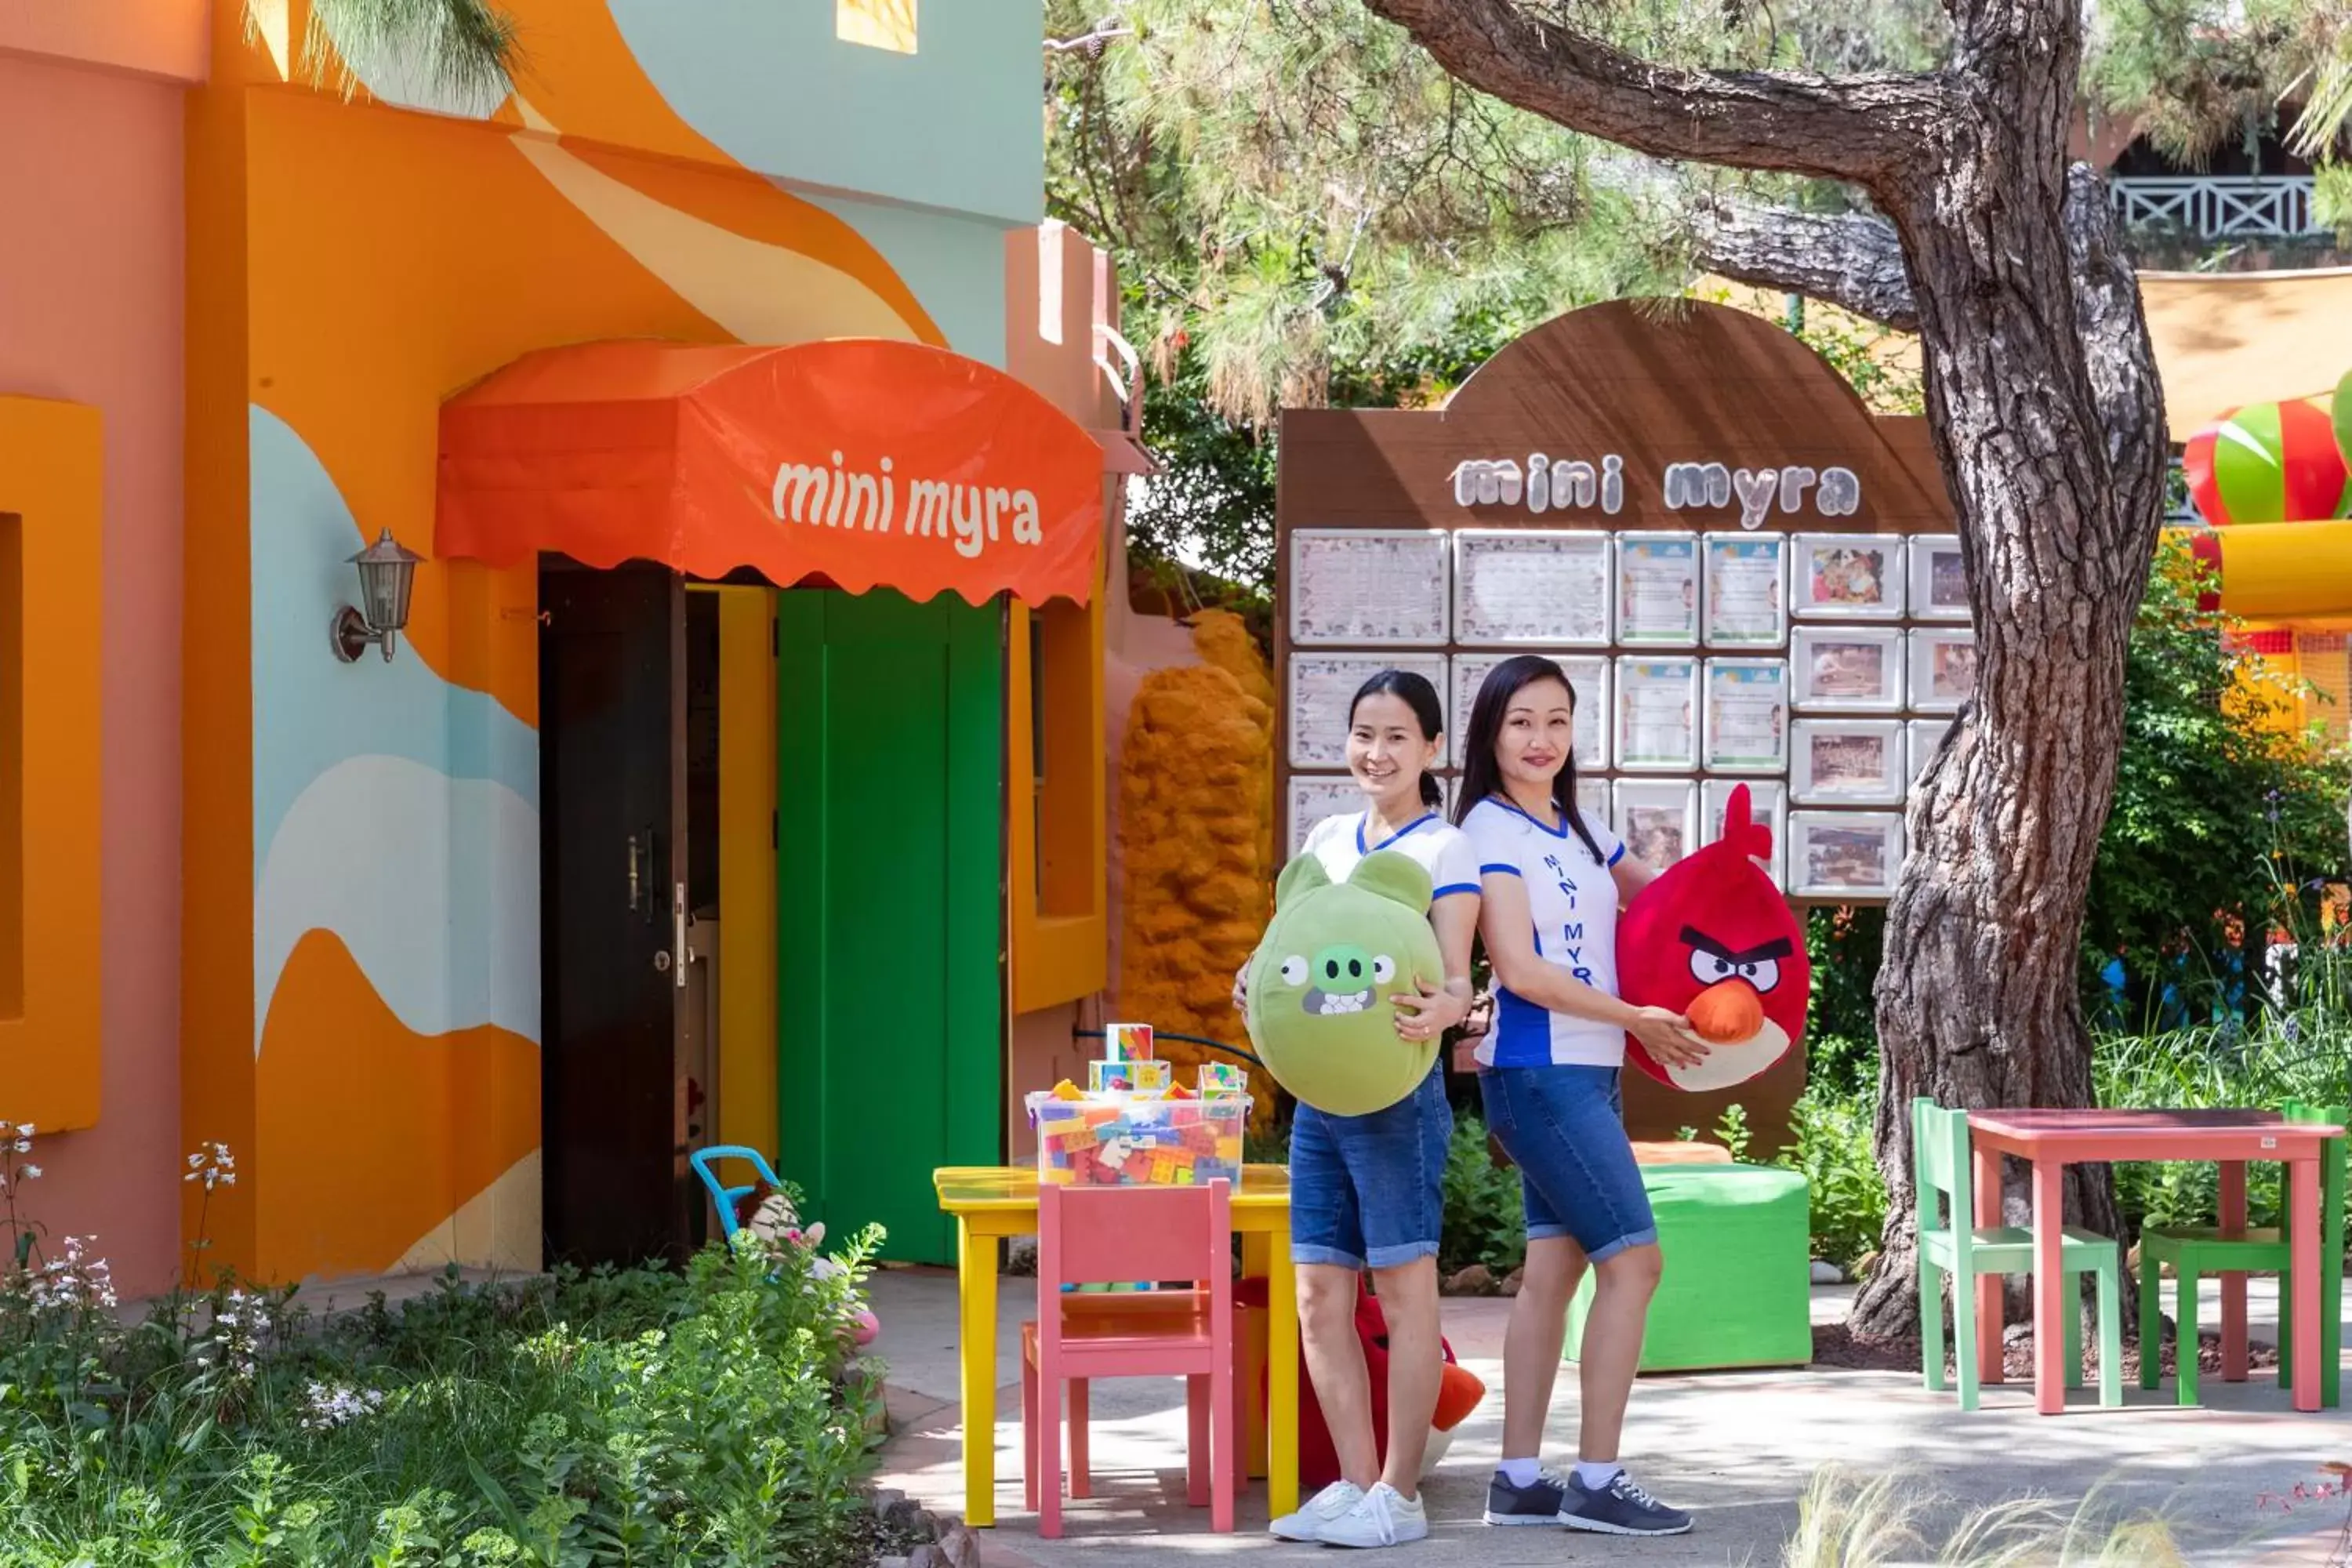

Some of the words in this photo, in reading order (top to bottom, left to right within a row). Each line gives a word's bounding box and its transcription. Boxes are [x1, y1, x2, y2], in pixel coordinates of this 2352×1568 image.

[772, 448, 894, 533] mini
[904, 477, 1043, 558] myra
[1454, 452, 1624, 514] mini
[1664, 461, 1860, 530] myra
[1543, 853, 1578, 910] MINI
[1563, 922, 1594, 988] MYR
